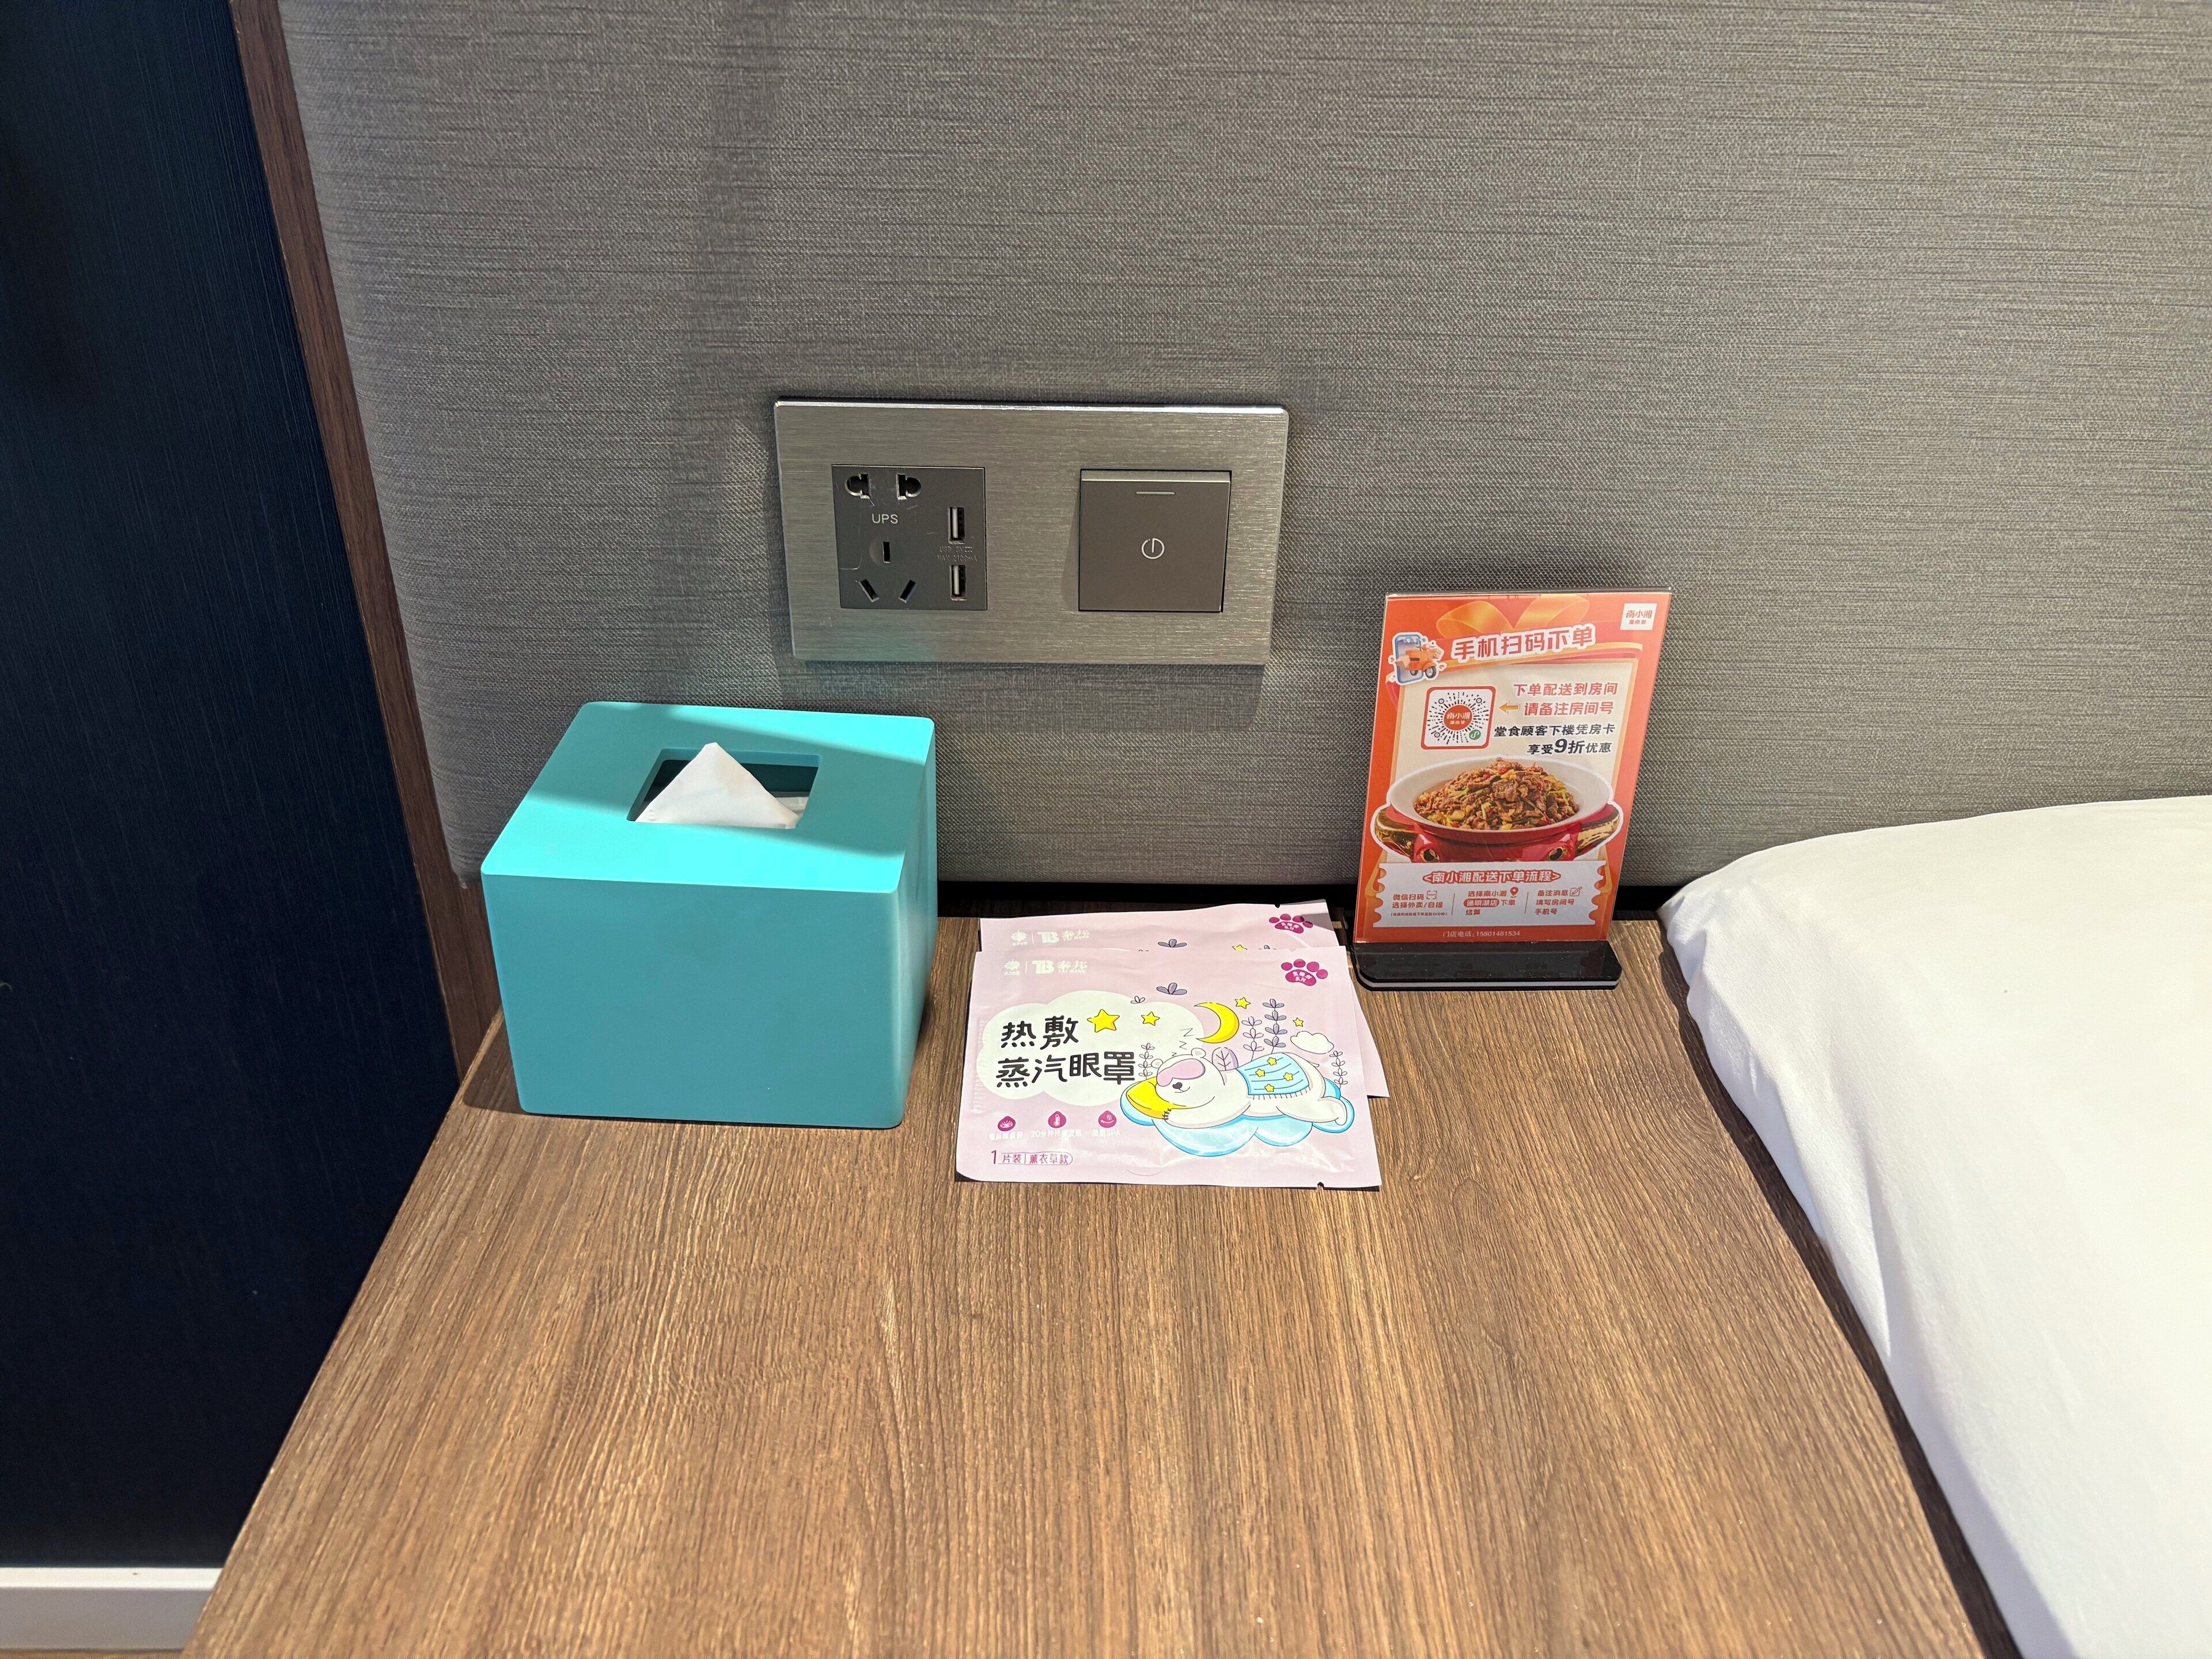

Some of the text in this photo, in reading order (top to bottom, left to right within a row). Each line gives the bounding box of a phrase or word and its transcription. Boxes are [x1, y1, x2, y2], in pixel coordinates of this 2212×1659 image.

[872, 513, 898, 524] UPS
[1626, 610, 1653, 619] 南小湘
[1454, 626, 1593, 660] 手机扫码下单
[1513, 682, 1618, 696] 下单配送到房间
[1524, 702, 1613, 715] 请备注房间号
[1494, 724, 1615, 737] 堂食顾客下楼凭房卡
[1527, 738, 1612, 755] 享受9折优惠
[1001, 1015, 1079, 1050] 热敷
[995, 1051, 1135, 1088] 蒸汽眼罩
